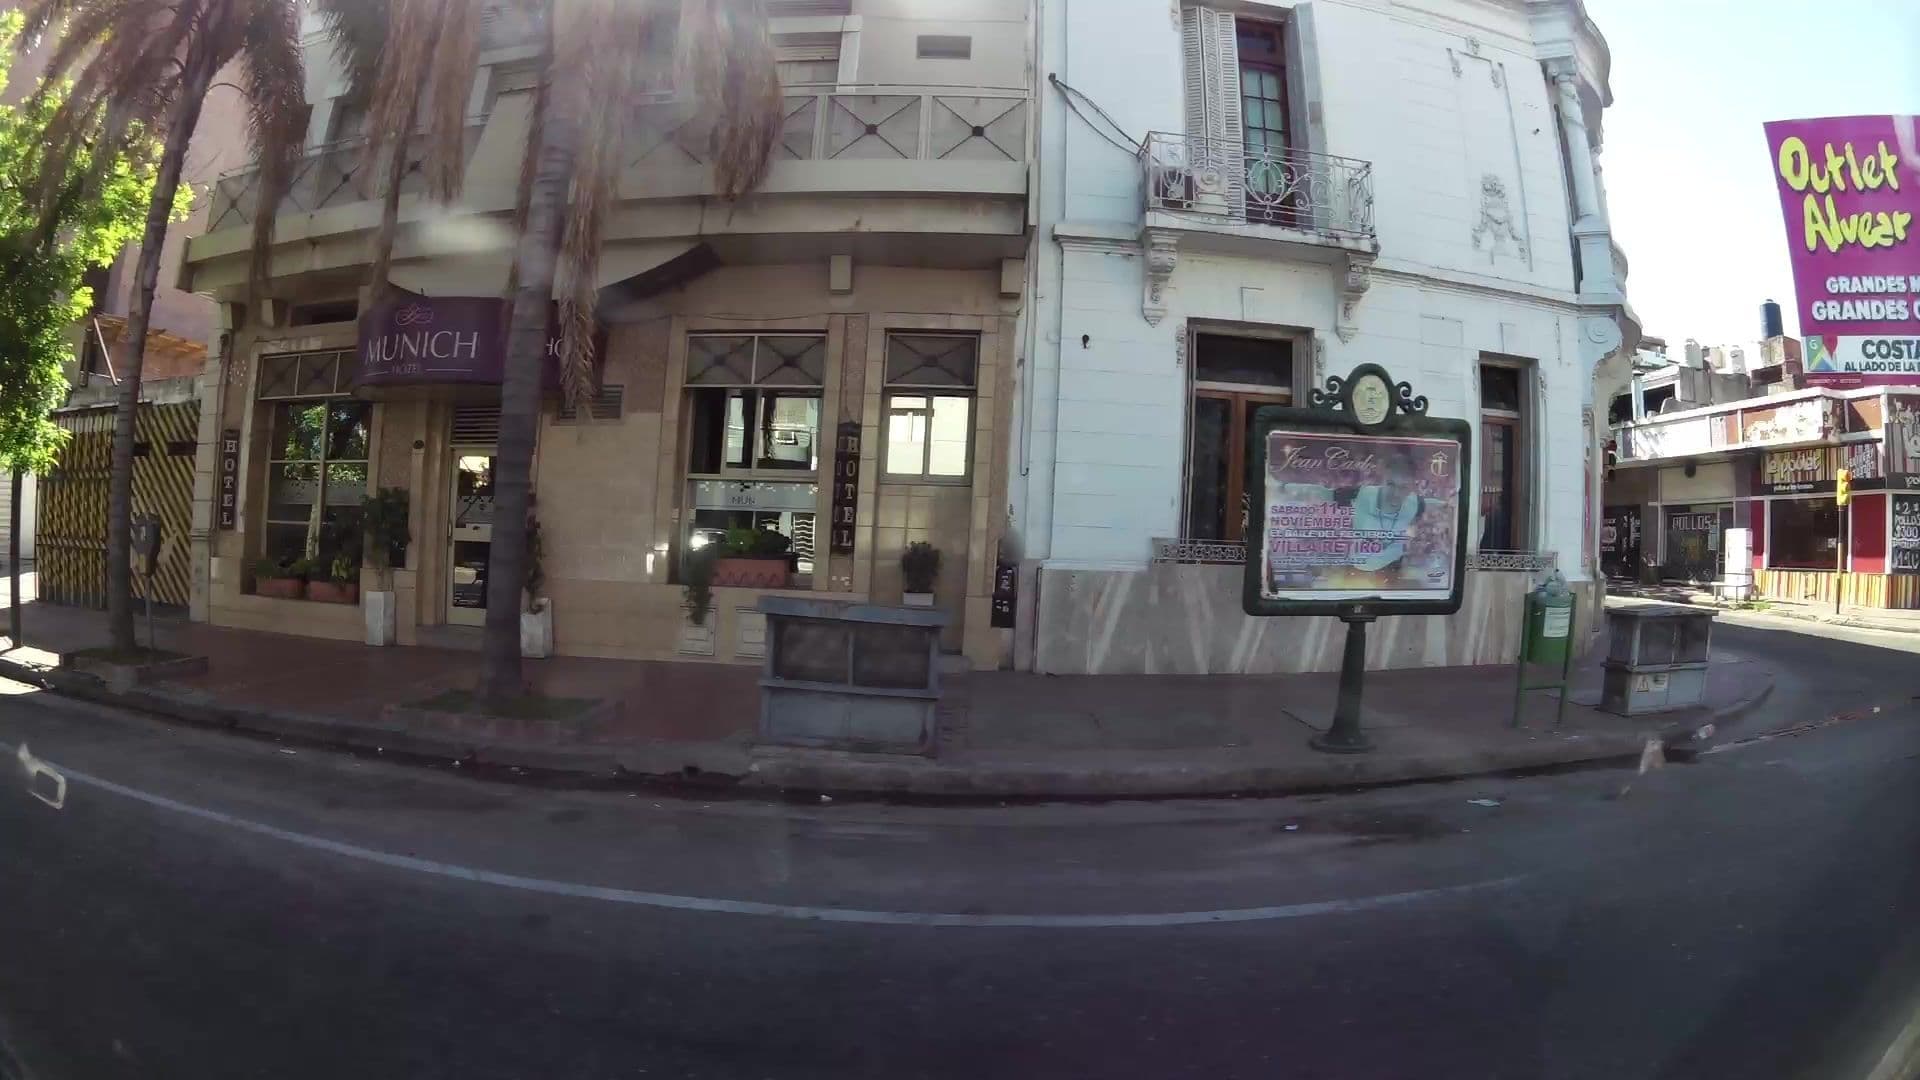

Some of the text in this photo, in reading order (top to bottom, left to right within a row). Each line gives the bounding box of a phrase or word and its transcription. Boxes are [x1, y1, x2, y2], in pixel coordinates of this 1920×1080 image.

[1778, 136, 1899, 193] Outlet
[1803, 193, 1911, 252] Alvear
[1826, 276, 1906, 293] GRANDES
[1811, 300, 1909, 320] GRANDES
[364, 331, 480, 365] MUNICH
[1845, 361, 1859, 372] AL
[1860, 361, 1886, 372] LADO
[1888, 361, 1901, 372] DE
[1903, 361, 1916, 372] LA
[220, 439, 238, 526] HOTEL
[841, 436, 859, 548] HOTEL
[1271, 505, 1316, 515] SABADO
[1319, 502, 1338, 515] 11
[1271, 517, 1350, 529] NOVIEMBRE
[1672, 514, 1712, 531] POLLOS
[1271, 541, 1319, 554] VILLA
